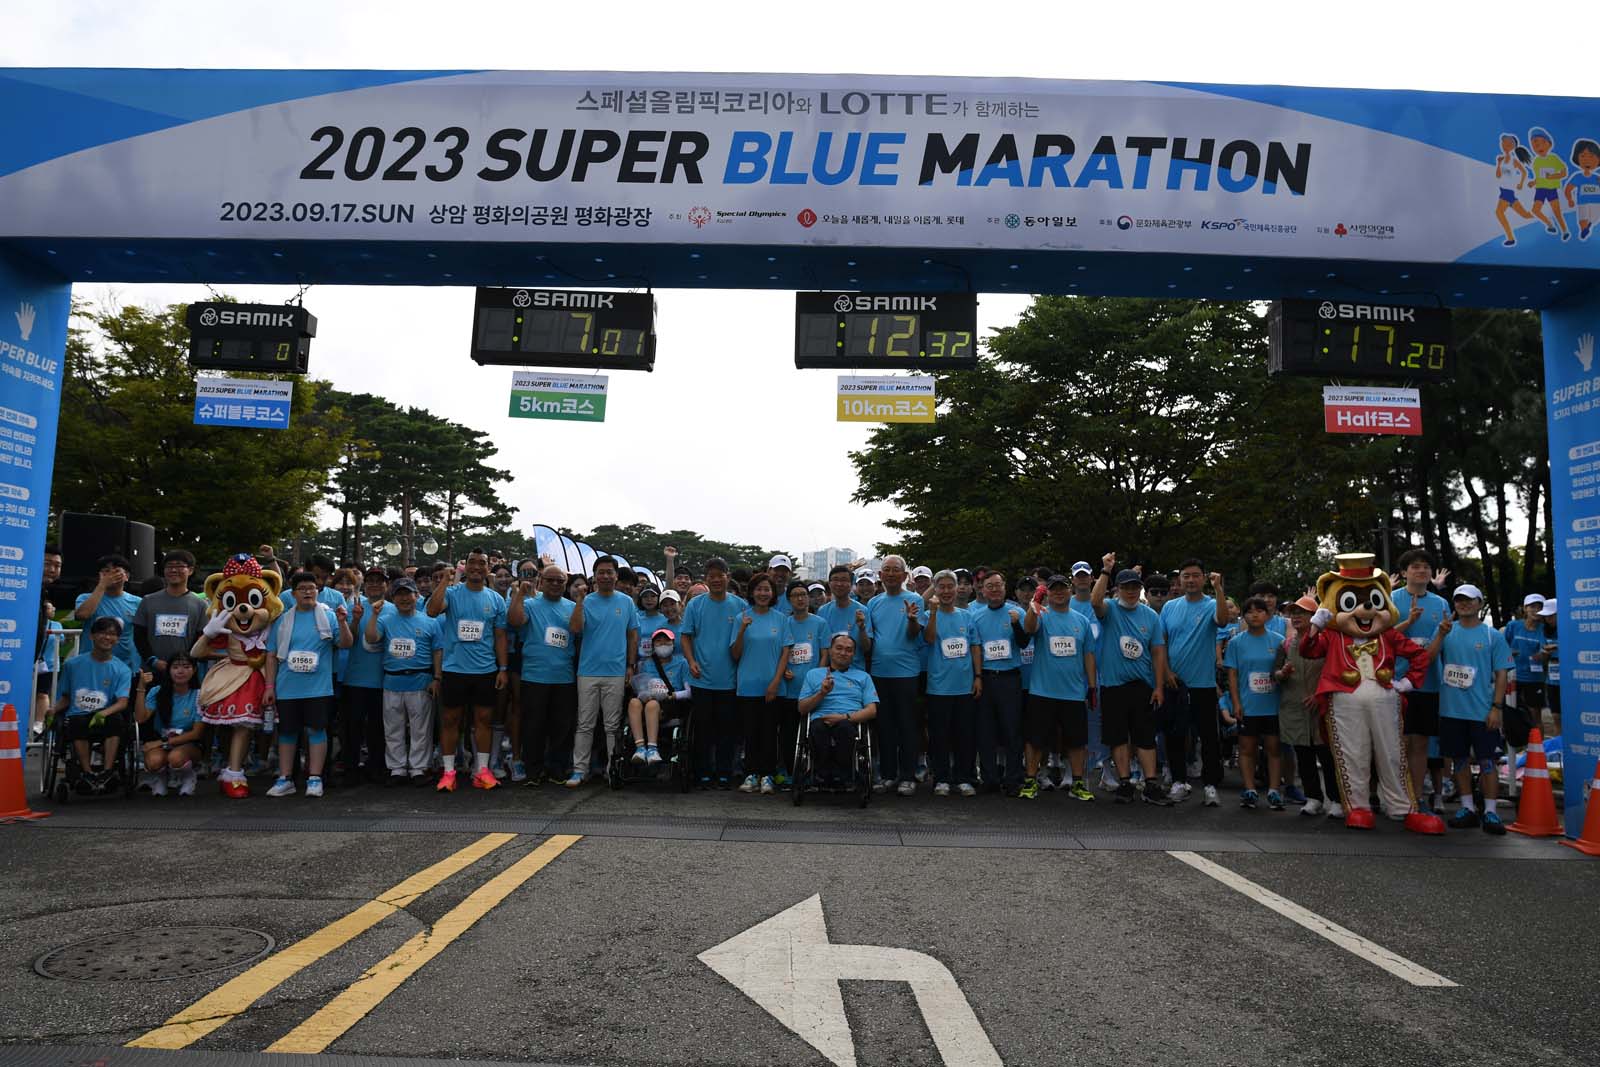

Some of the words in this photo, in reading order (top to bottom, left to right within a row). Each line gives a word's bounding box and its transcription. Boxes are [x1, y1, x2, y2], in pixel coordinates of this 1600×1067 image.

[575, 89, 812, 115] 스페셜올림픽코리아와
[975, 99, 1040, 119] 함께하는
[299, 125, 470, 183] 2023
[476, 127, 710, 185] SUPER
[722, 130, 907, 187] BLUE
[918, 132, 1312, 197] MARATHON
[219, 201, 415, 225] 2023.09.17.SUN
[428, 203, 468, 226] 상암
[472, 204, 569, 227] 평화의공원
[574, 205, 653, 228] 평화광장
[716, 210, 747, 219] Special
[748, 210, 787, 219] Olympics
[822, 214, 848, 225] 오늘을
[884, 214, 911, 225] 내일을
[946, 215, 965, 225] 롯데
[1023, 215, 1078, 228] 동아일보
[1135, 218, 1192, 229] 문화체육관광부
[1200, 219, 1237, 231] KSPO
[1243, 222, 1298, 234] 국민체육진흥공단
[1349, 224, 1395, 235] 사랑의열매
[534, 291, 615, 309] SAMIK
[855, 296, 937, 311] SAMIK
[220, 310, 294, 327] SAMIK
[1338, 303, 1416, 322] SAMIK
[0, 340, 26, 363] PER
[25, 350, 58, 375] BLUE
[1552, 379, 1591, 405] SUPER
[199, 403, 285, 421] 슈퍼블루코스
[519, 395, 595, 415] 5km코스
[843, 399, 929, 417] 10km코스
[1336, 410, 1411, 428] Half코스
